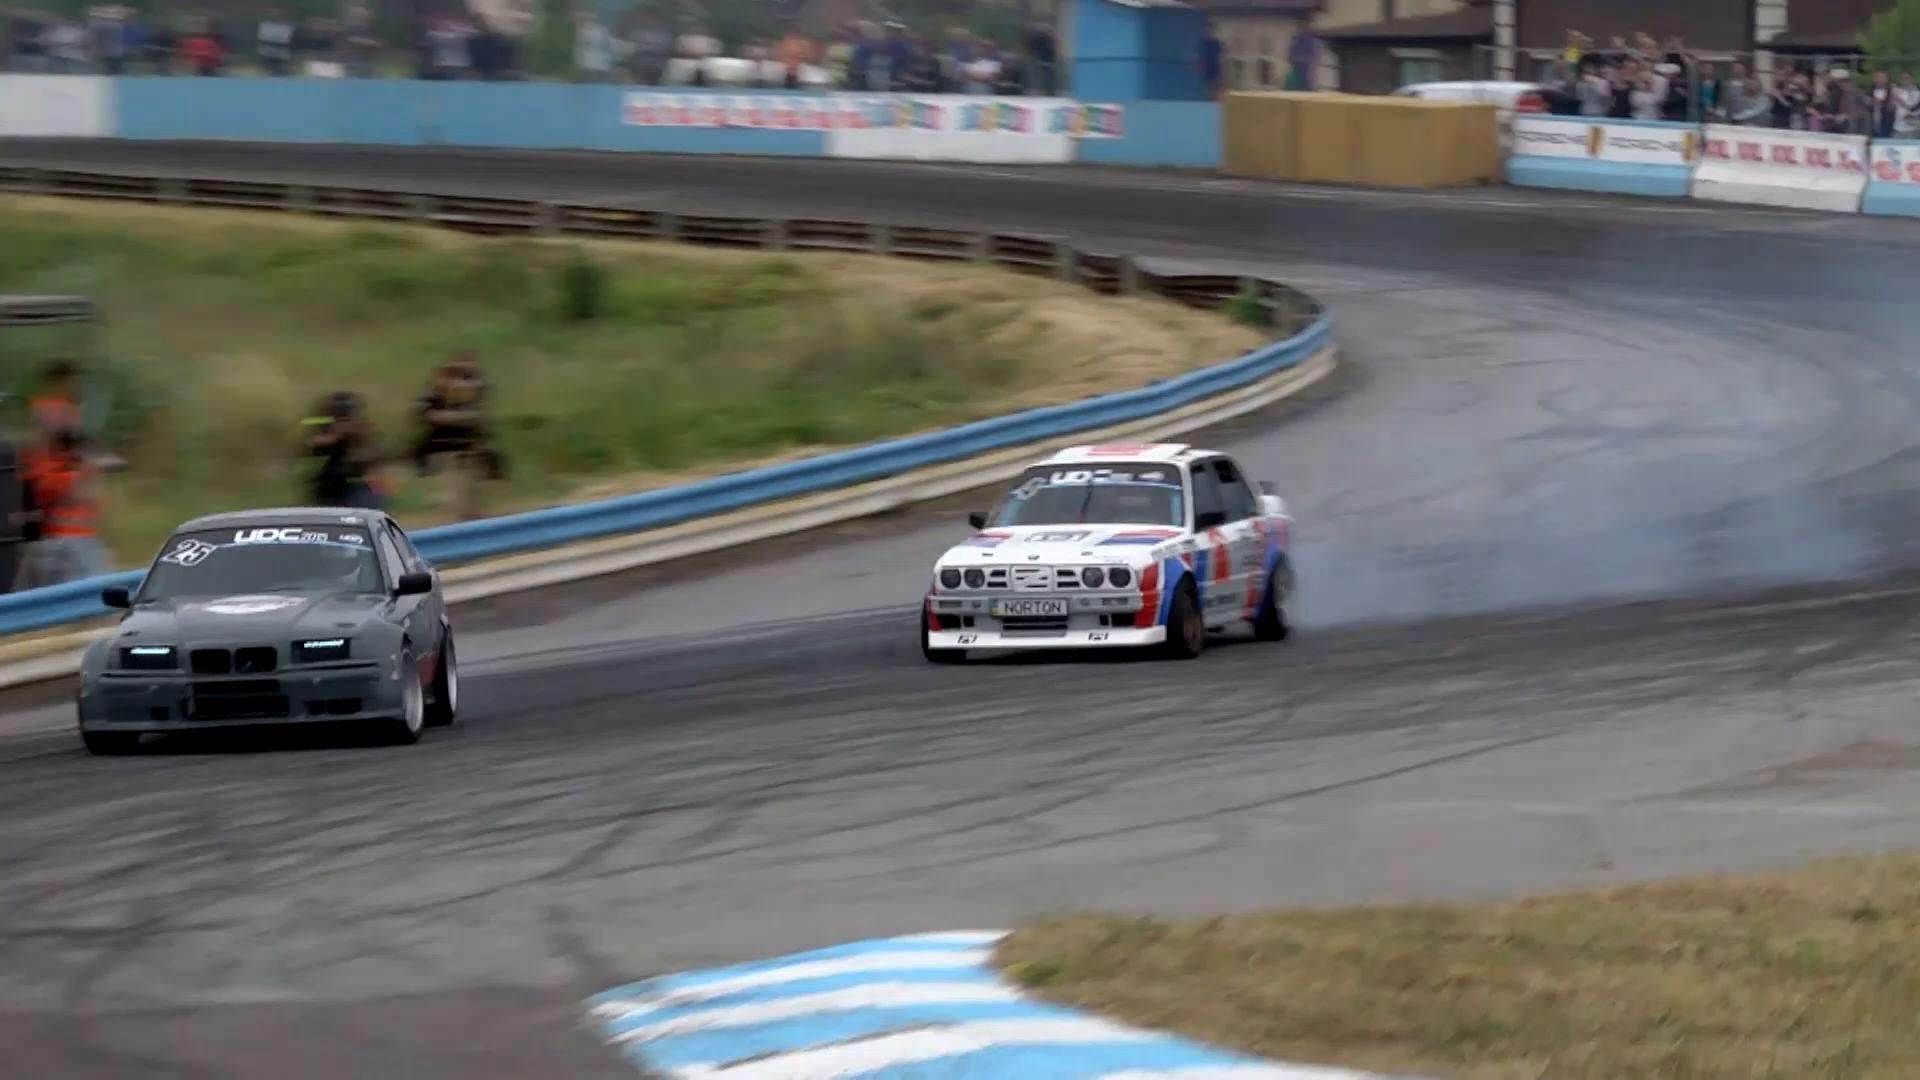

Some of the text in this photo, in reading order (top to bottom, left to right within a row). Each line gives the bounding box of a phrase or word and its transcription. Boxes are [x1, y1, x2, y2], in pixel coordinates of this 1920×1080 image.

[233, 528, 303, 543] UDC
[160, 539, 217, 566] 25
[1004, 601, 1062, 615] NORTON
